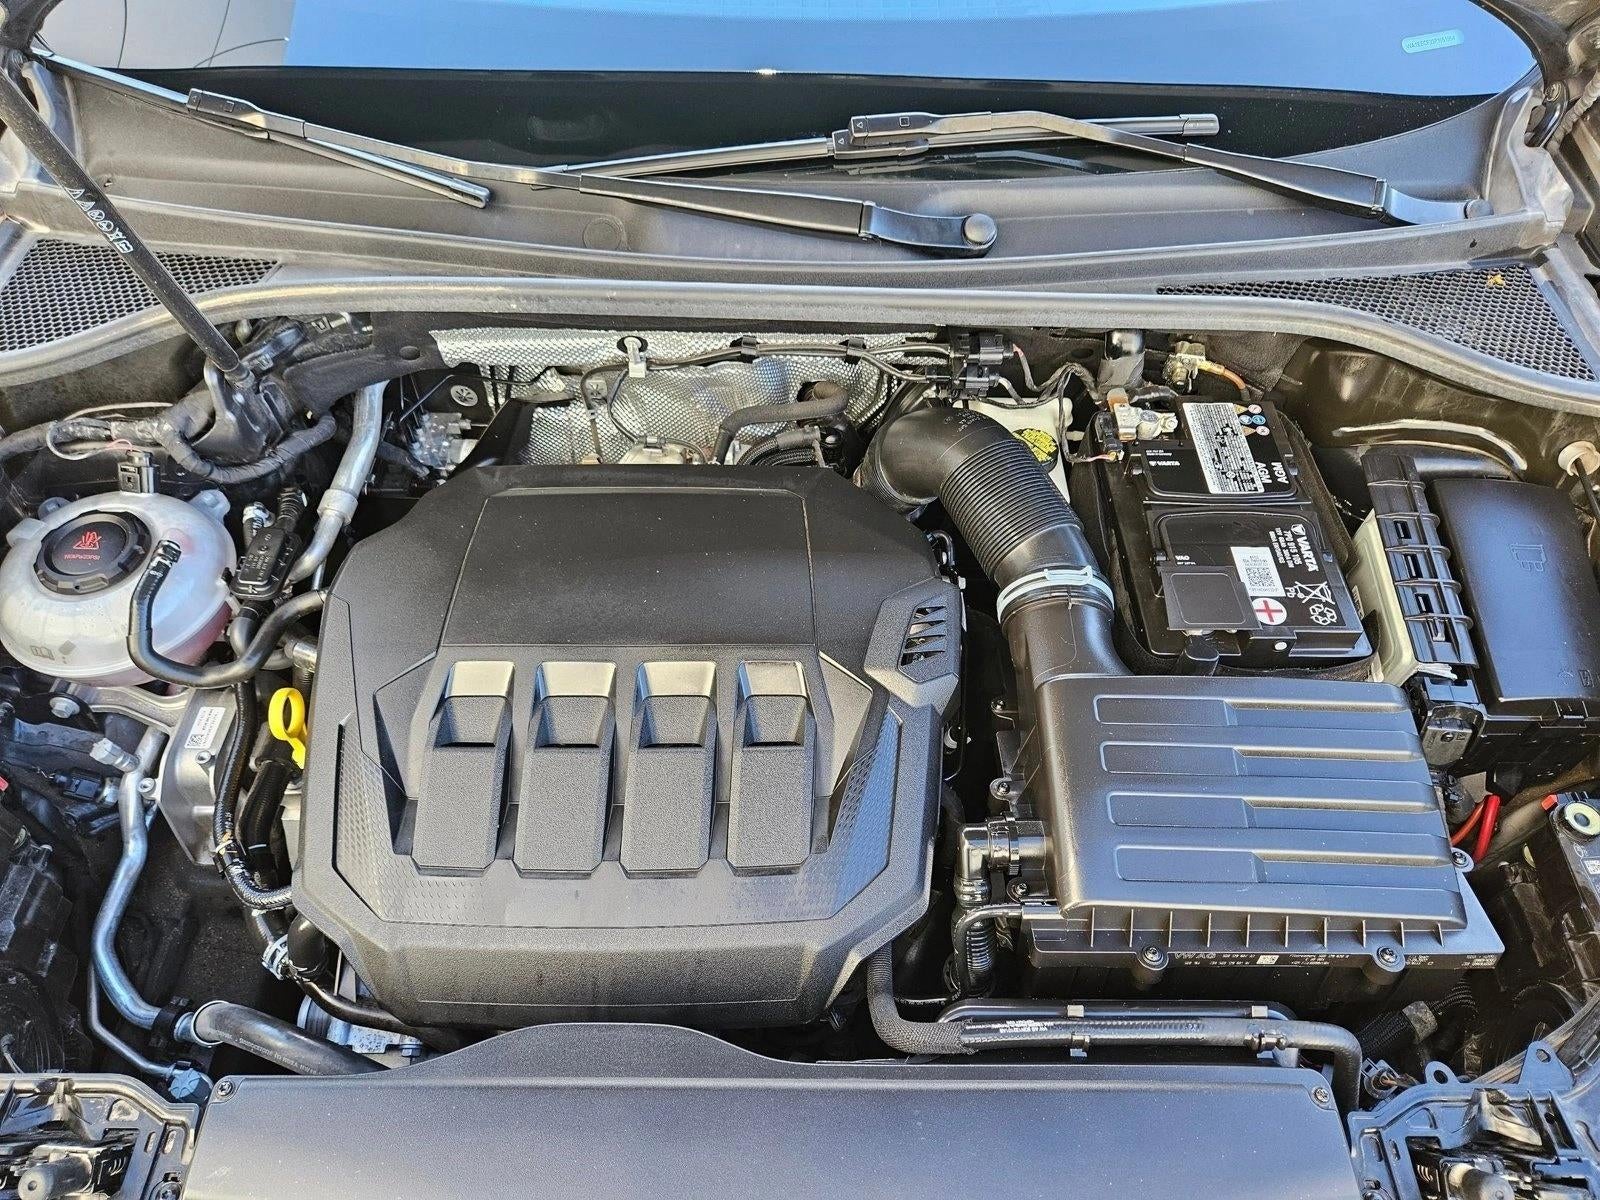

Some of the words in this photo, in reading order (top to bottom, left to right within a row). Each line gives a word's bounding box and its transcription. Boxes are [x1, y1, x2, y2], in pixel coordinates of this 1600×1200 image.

[1255, 461, 1272, 483] AGM
[1271, 462, 1289, 484] AGM
[1296, 535, 1319, 572] VARTA
[1285, 587, 1296, 598] Pb
